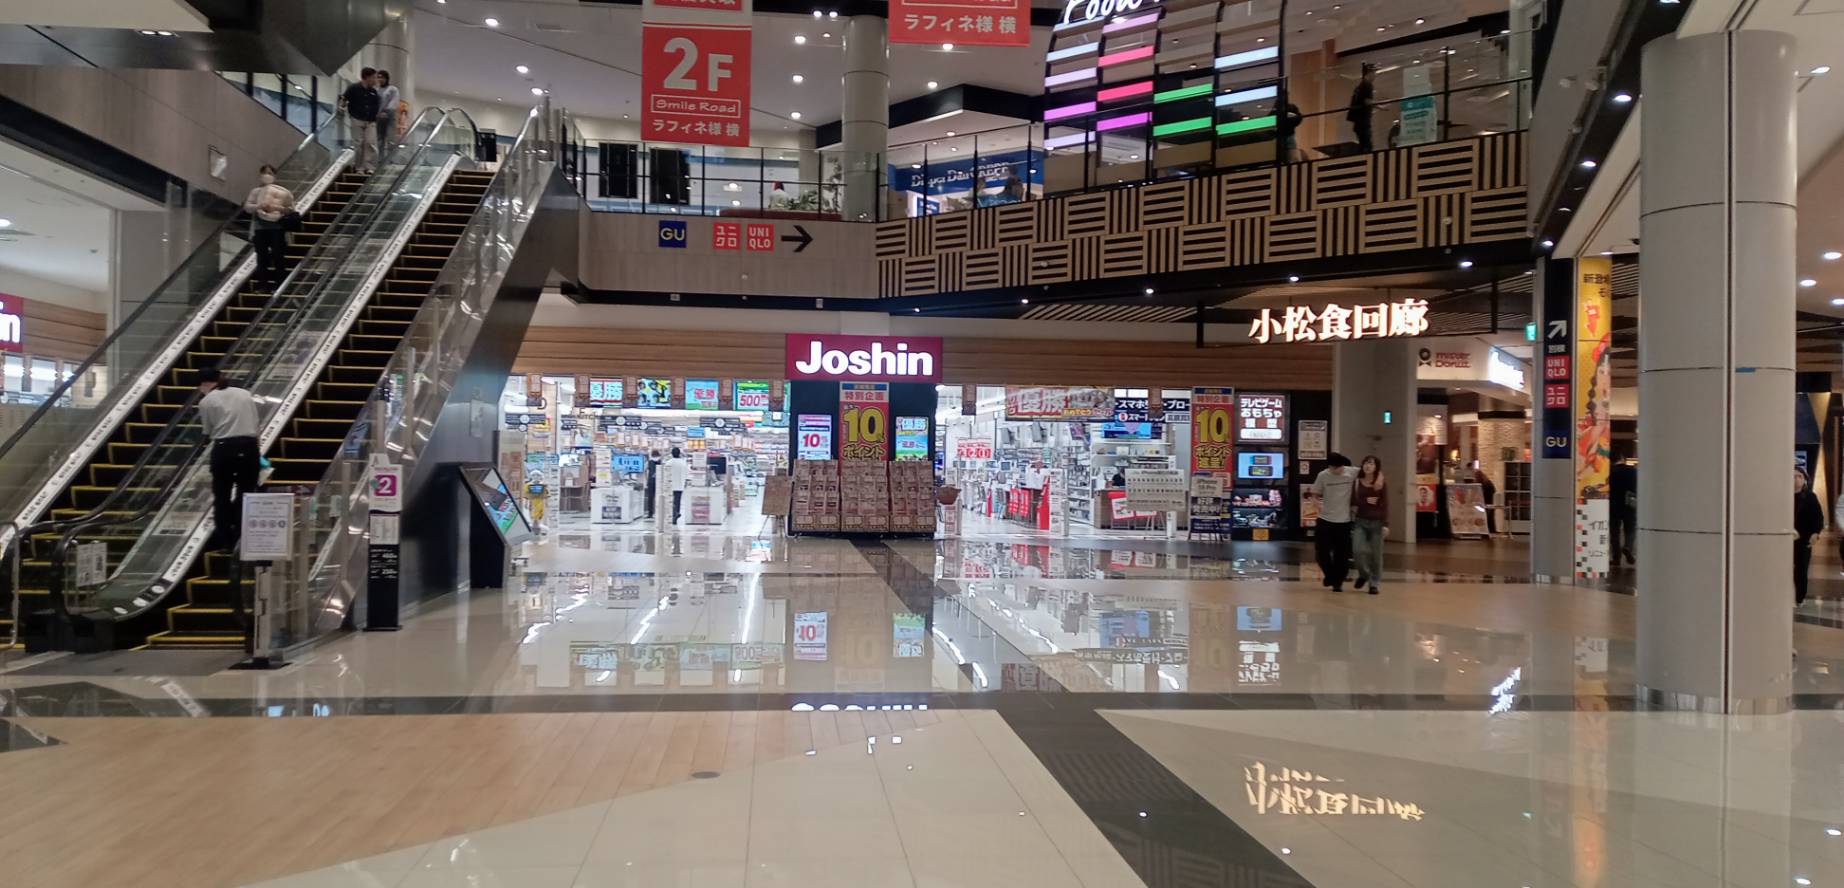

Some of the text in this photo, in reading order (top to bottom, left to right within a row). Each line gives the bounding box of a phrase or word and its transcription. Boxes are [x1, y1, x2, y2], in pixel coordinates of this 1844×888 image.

[904, 14, 1017, 34] ラフィネ様 横
[663, 37, 734, 91] 2F
[656, 99, 736, 113] Smile Road
[653, 119, 739, 136] ラフィネ様 横
[660, 227, 685, 240] GU
[749, 227, 769, 236] UNI
[749, 238, 771, 248] QLO
[1249, 298, 1429, 344] 小松食回廊
[796, 341, 933, 376] Joshin
[1547, 359, 1565, 367] UNI
[1547, 368, 1566, 376] QLO
[1240, 398, 1283, 408] テレビゲーム
[1240, 408, 1283, 418] おもちゃ
[1545, 437, 1567, 447] GU
[379, 477, 392, 494] 2
